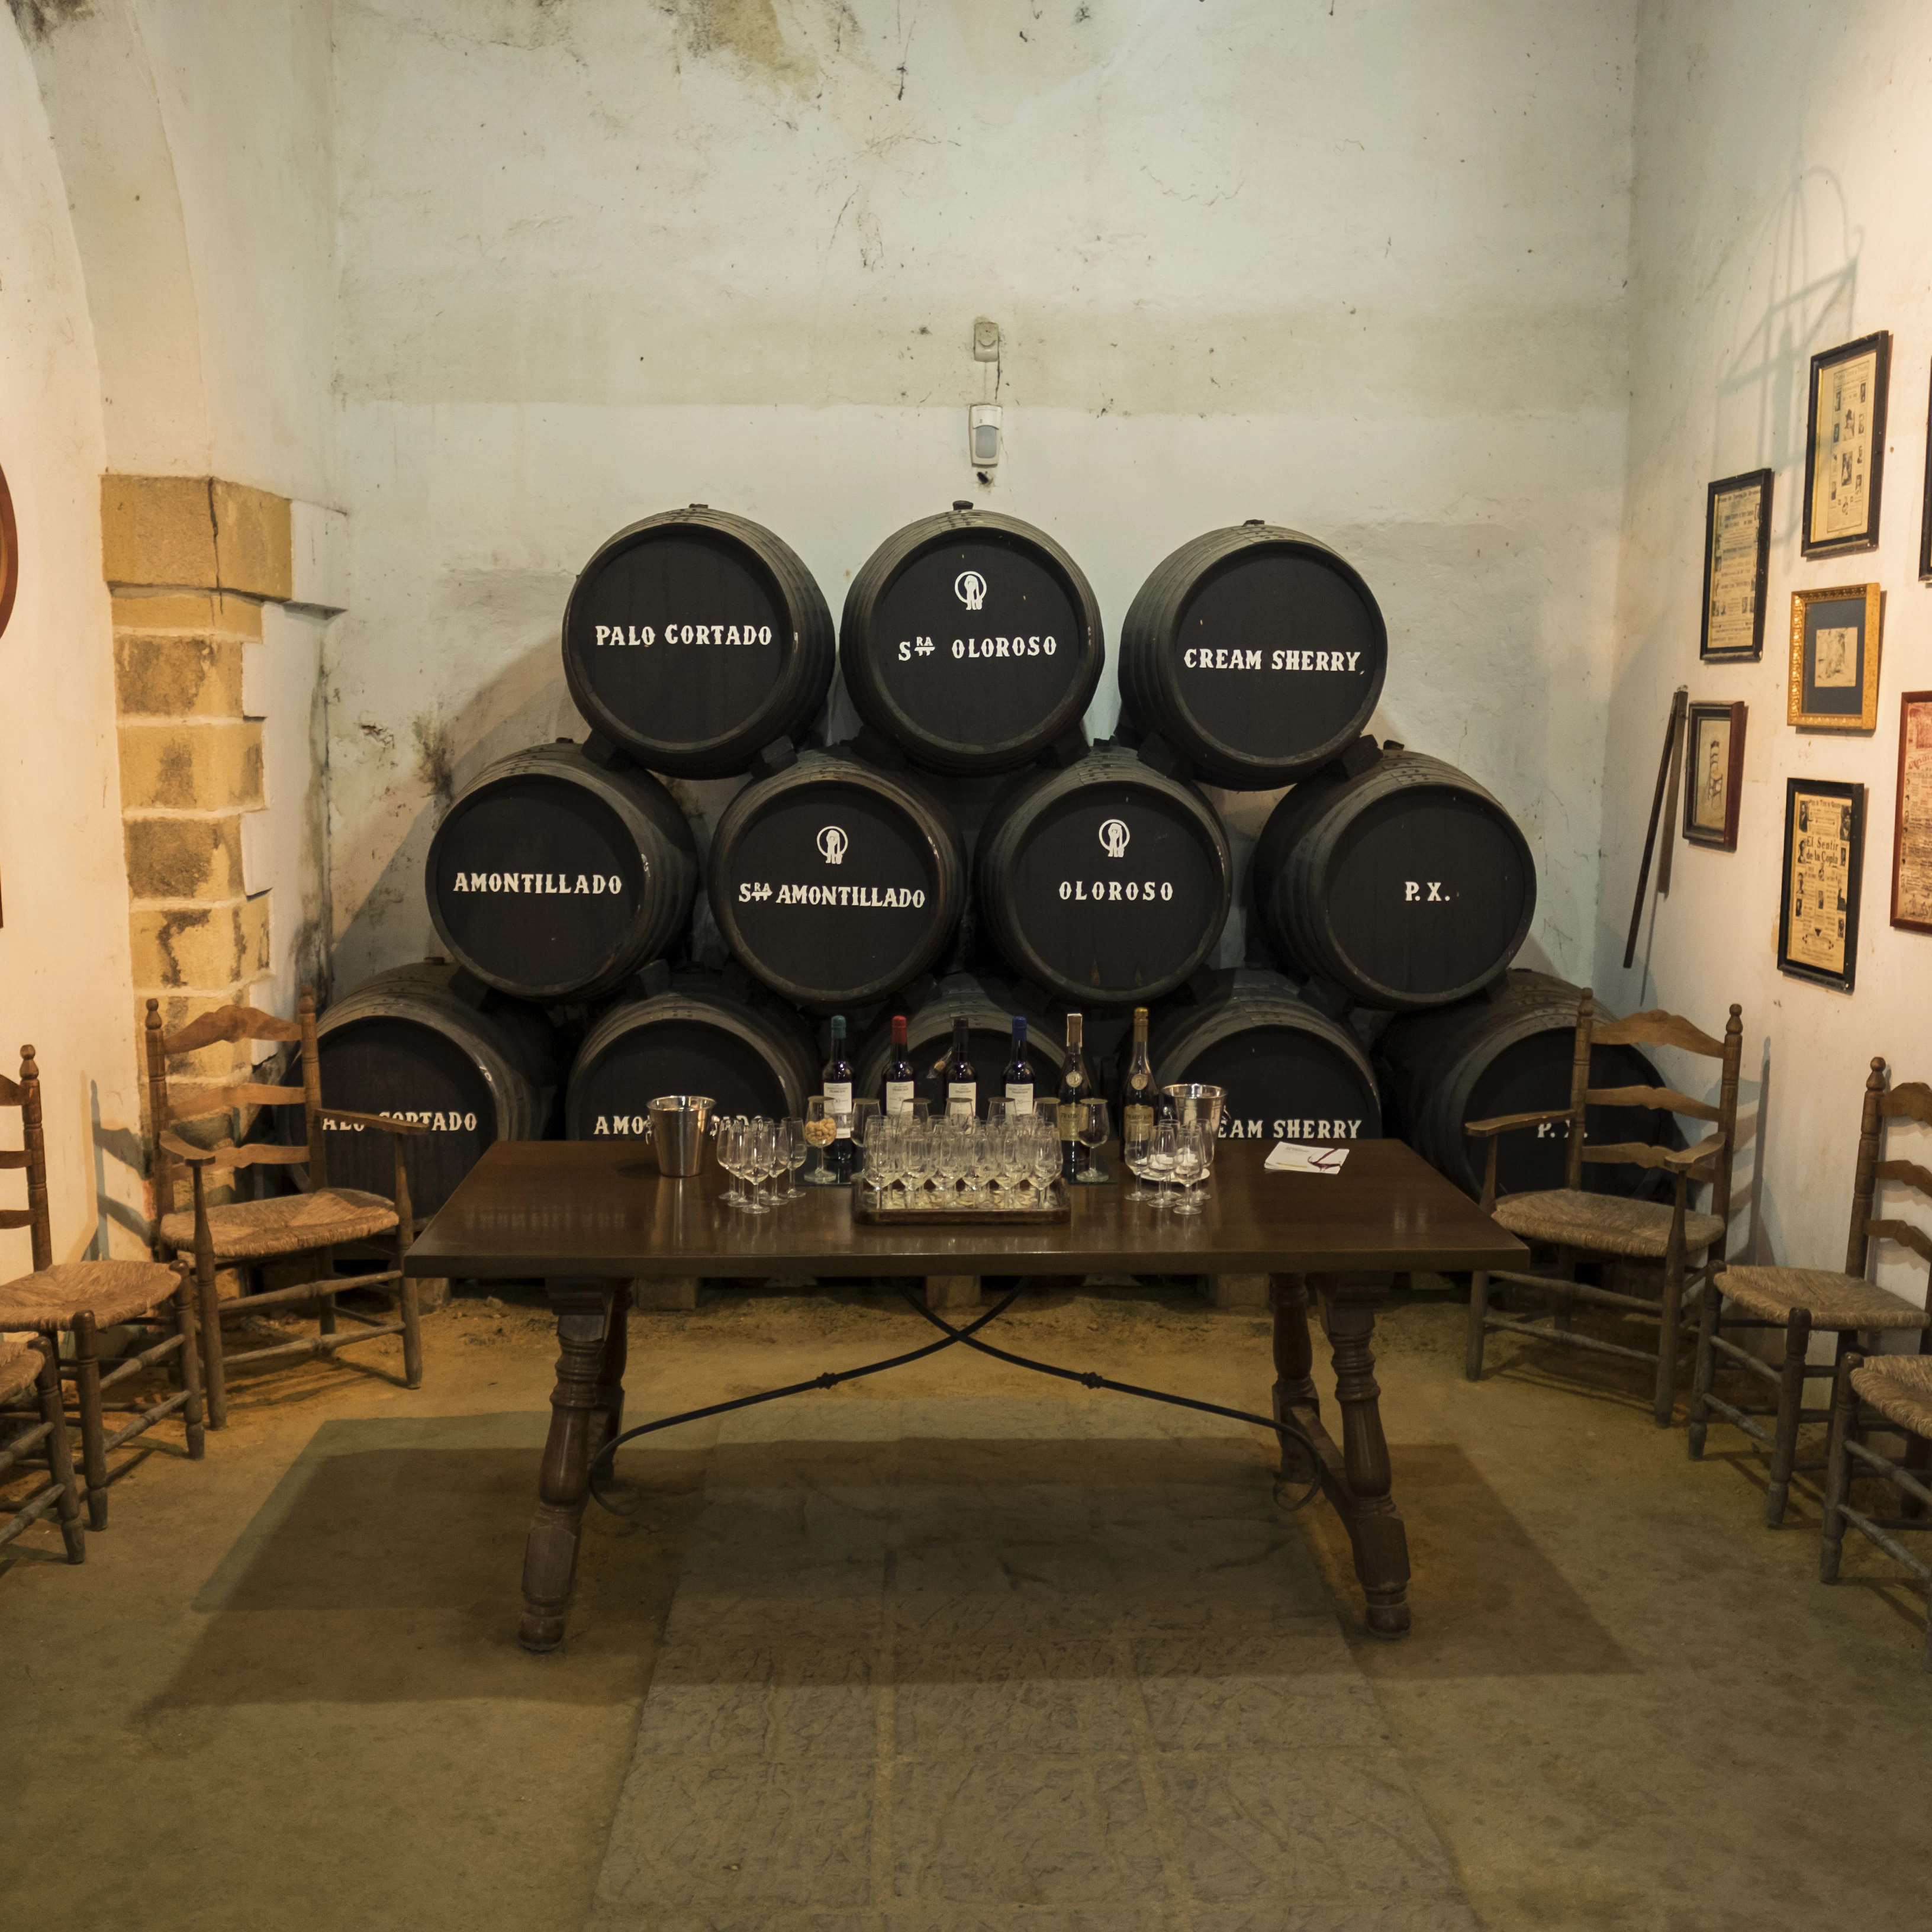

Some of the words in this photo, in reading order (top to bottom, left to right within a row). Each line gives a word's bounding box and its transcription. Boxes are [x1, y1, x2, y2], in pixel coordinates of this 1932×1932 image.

[595, 625, 656, 647] PALO
[664, 623, 772, 646] CORTADO
[951, 636, 1057, 659] OLOROSO
[1183, 648, 1263, 670] CREAM
[1271, 650, 1361, 671] SHERRY
[453, 872, 622, 894] AMONTILLADO
[1058, 881, 1173, 901] OLOROSO
[775, 884, 925, 909] AMONTILLADO
[1218, 1119, 1264, 1138] EAM
[1273, 1119, 1362, 1139] SHERRY
